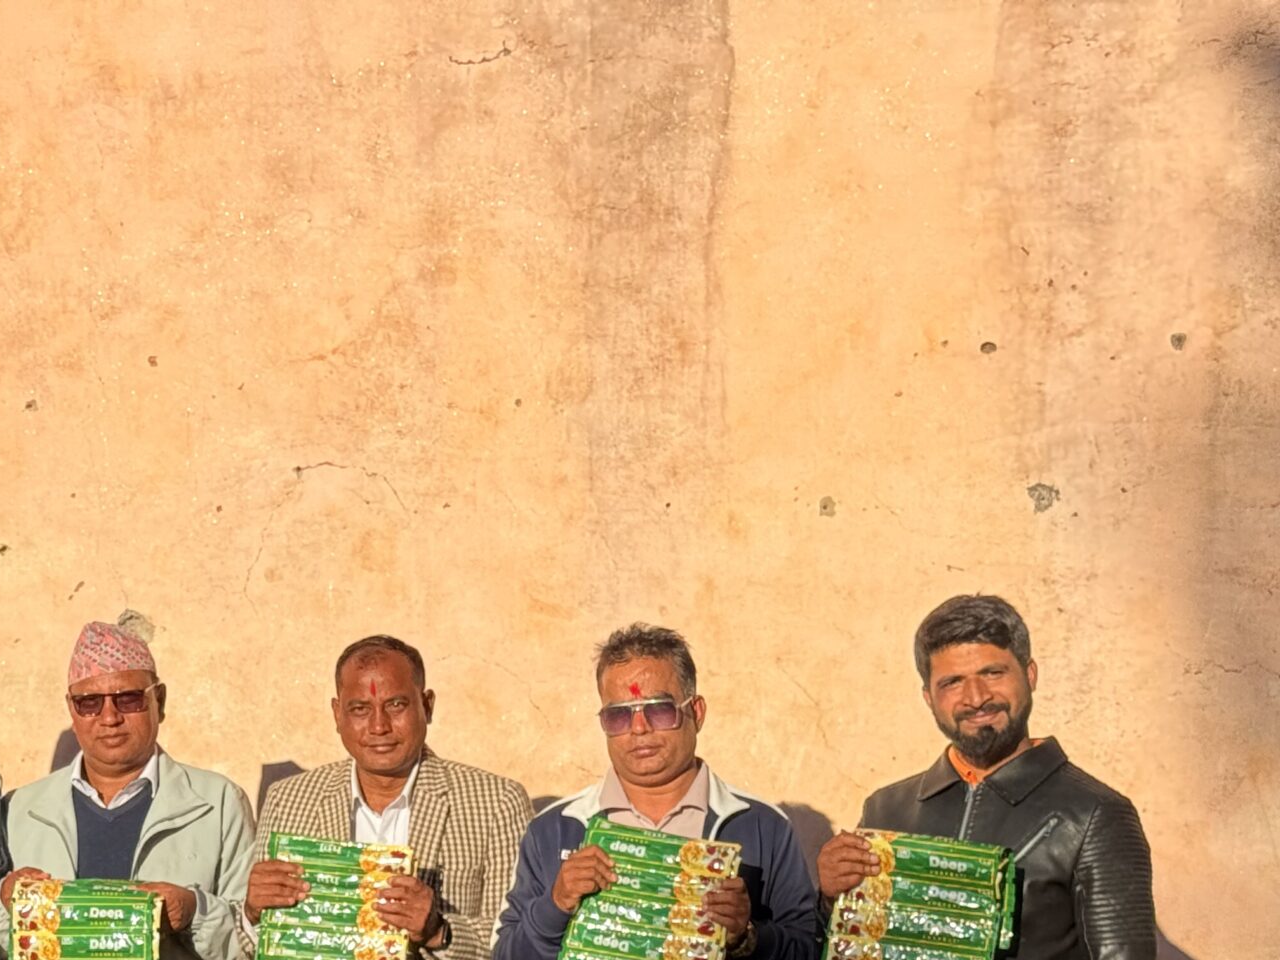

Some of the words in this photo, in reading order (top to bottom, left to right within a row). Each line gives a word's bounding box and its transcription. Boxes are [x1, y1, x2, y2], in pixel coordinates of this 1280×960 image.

[610, 840, 646, 857] Deep
[929, 855, 968, 872] Deep
[89, 907, 124, 919] Deep
[594, 935, 630, 952] Deep
